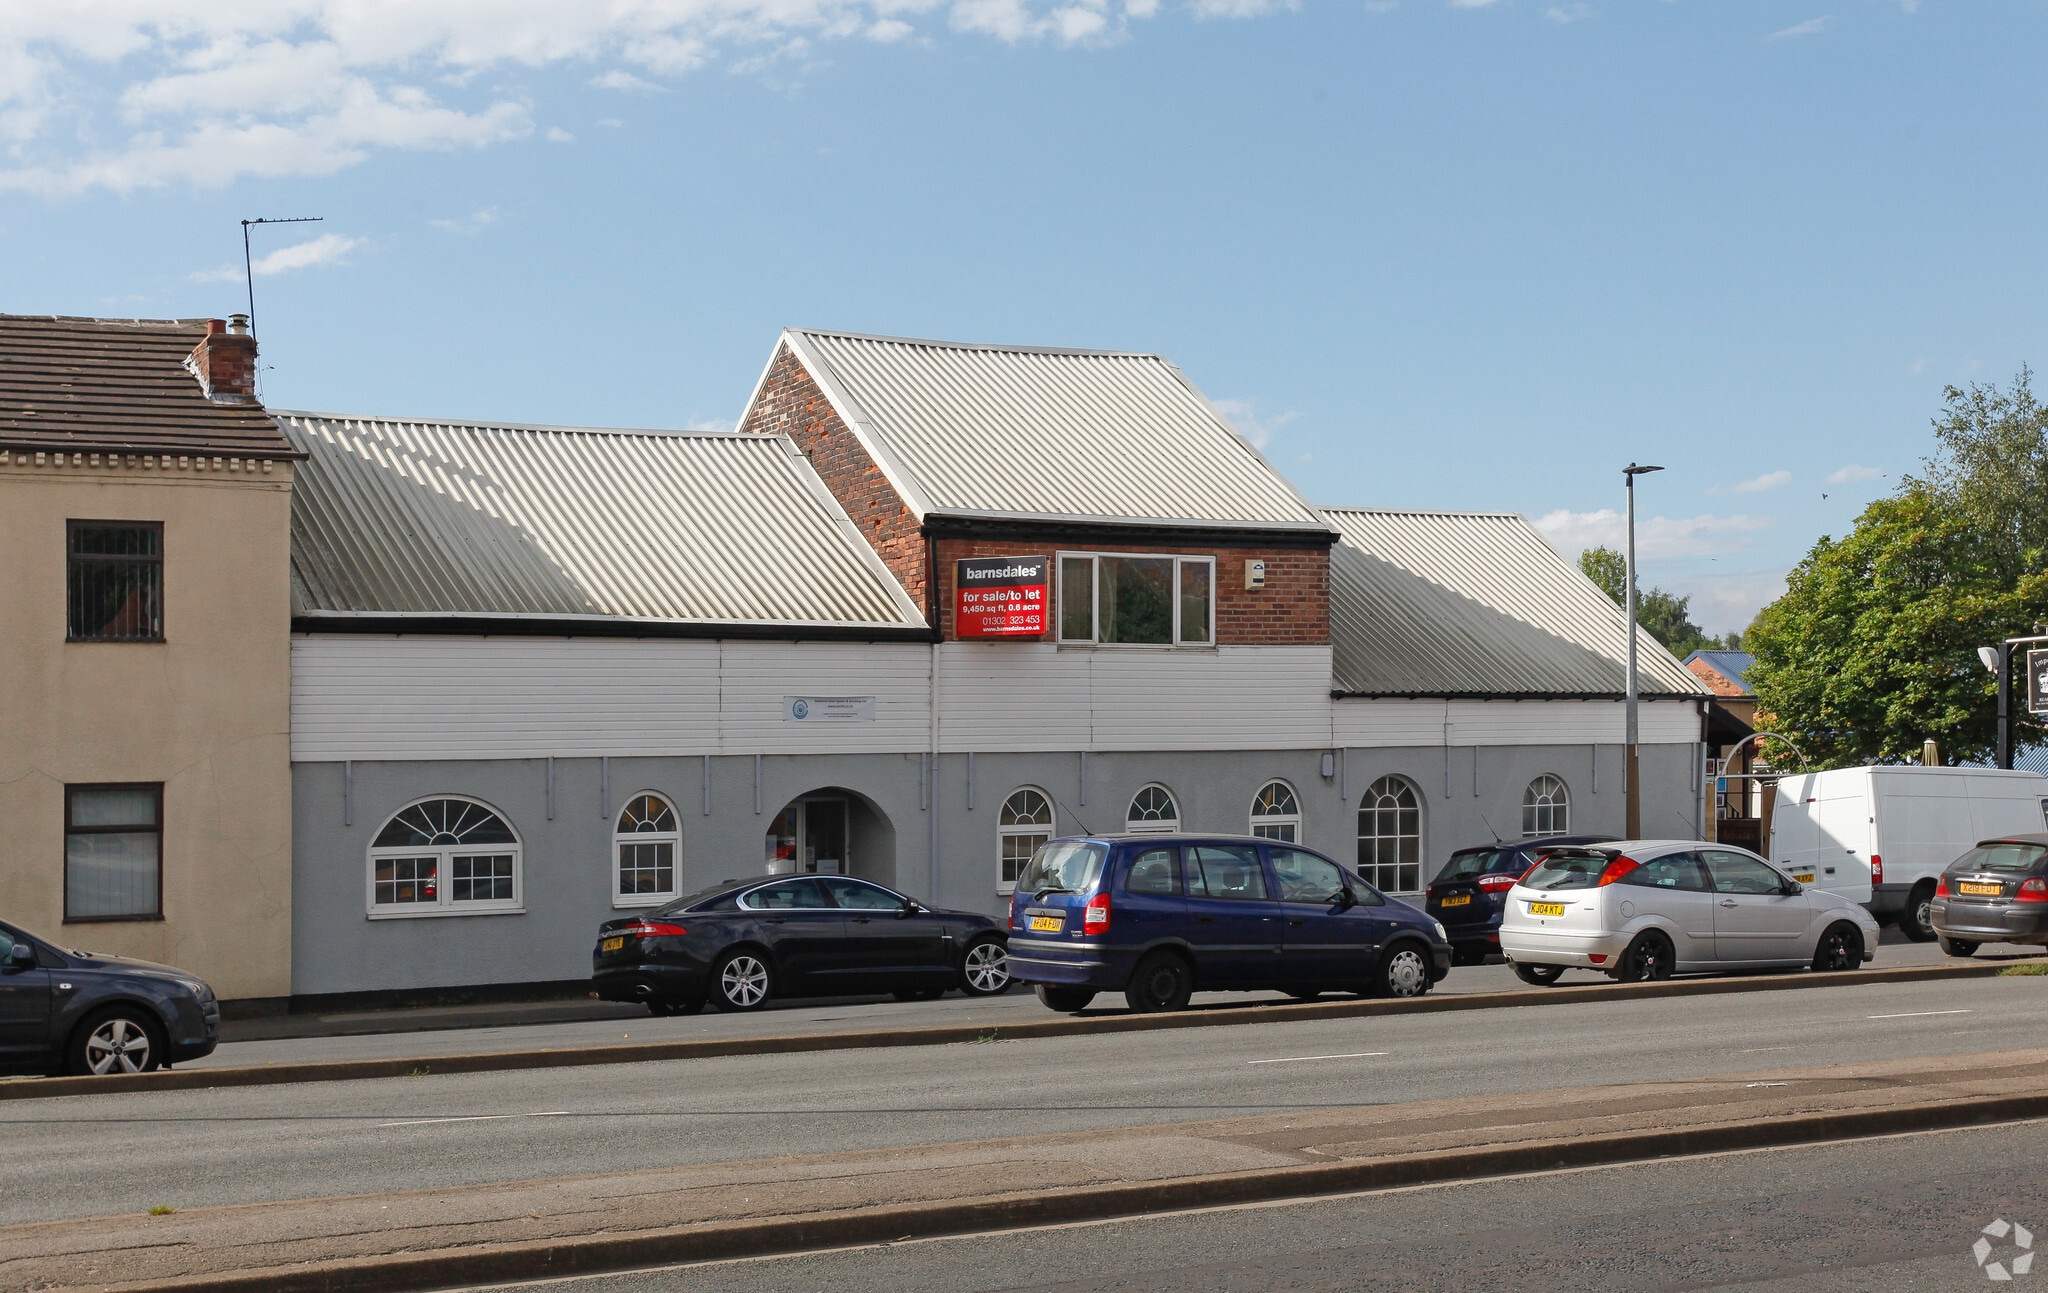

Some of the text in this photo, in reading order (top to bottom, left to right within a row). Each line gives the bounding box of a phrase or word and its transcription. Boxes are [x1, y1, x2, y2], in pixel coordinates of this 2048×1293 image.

[963, 589, 1040, 602] for sale/to let
[963, 605, 984, 613] 9,450
[983, 615, 1040, 625] 01302 323 453
[1962, 884, 1979, 892] X219
[1531, 904, 1563, 915] KJ04 KTJ
